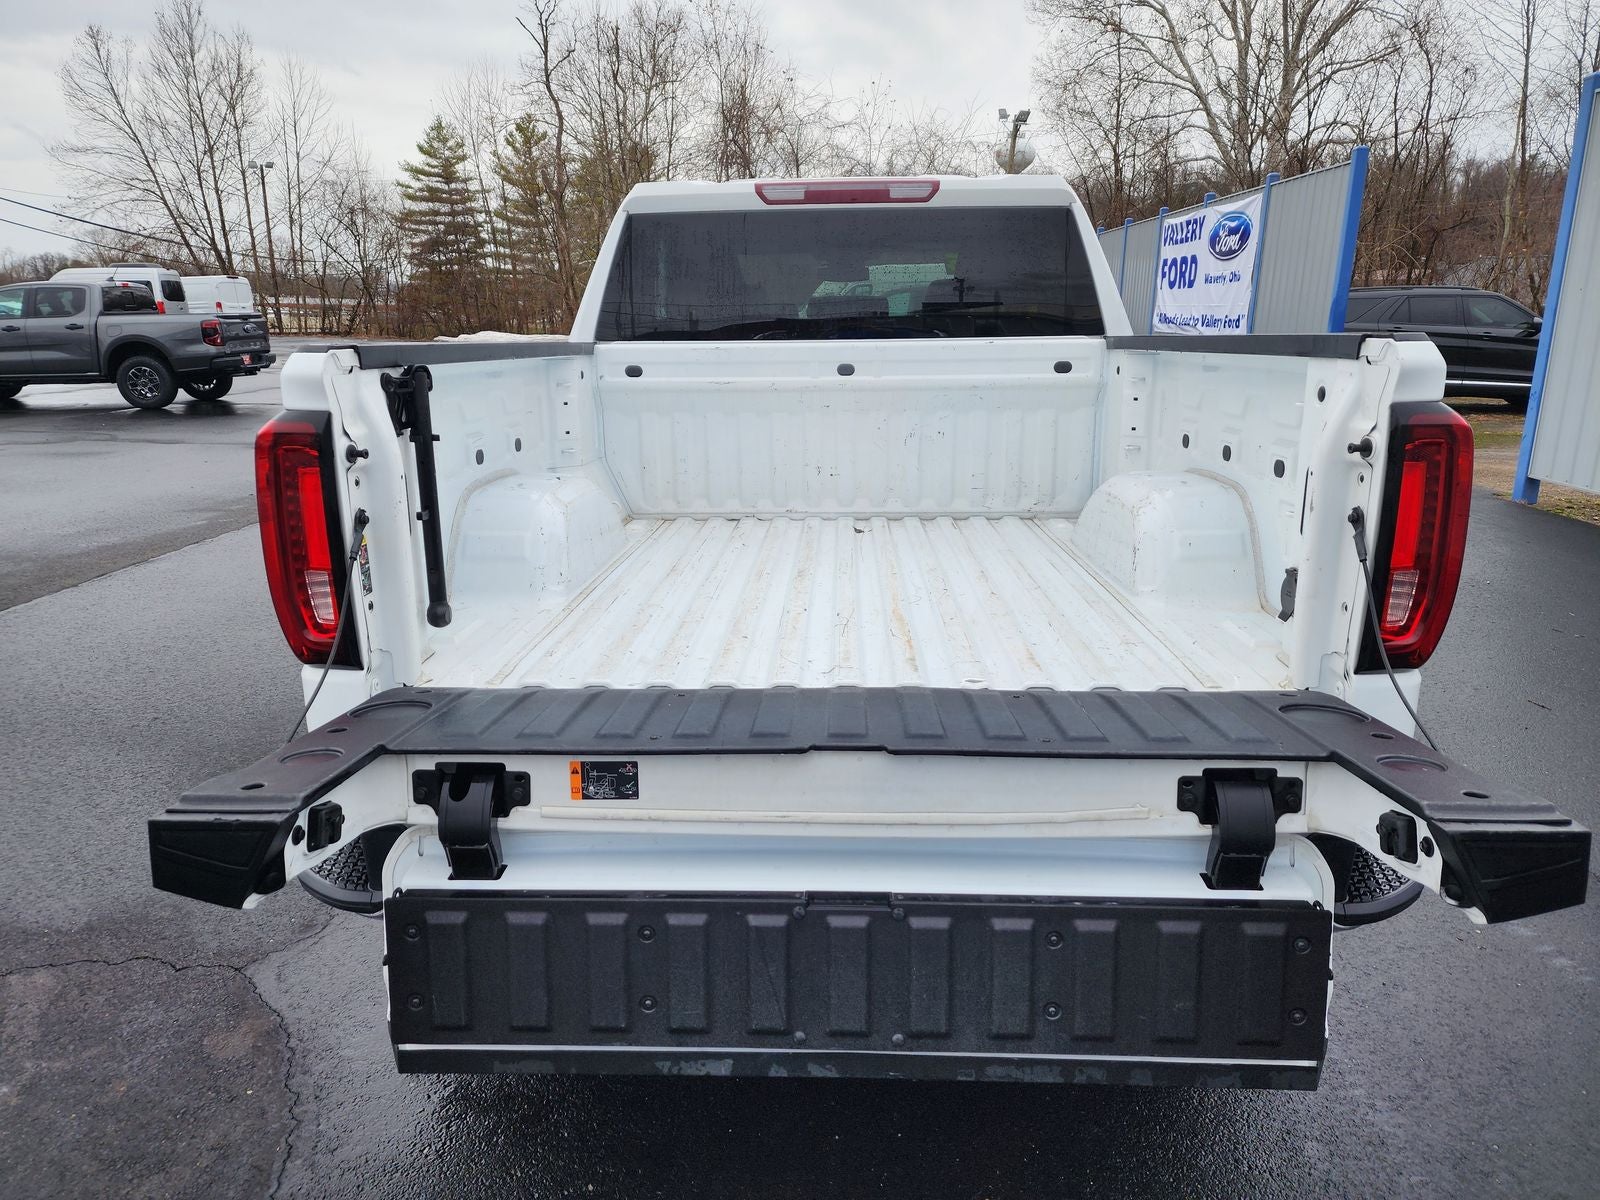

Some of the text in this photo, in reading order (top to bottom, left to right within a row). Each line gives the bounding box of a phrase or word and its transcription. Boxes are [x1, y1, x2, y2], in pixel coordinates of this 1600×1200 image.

[1163, 215, 1206, 247] VALLERY
[1215, 221, 1247, 253] Ford
[1160, 254, 1198, 290] FORD
[1228, 270, 1241, 283] Ohio
[1201, 314, 1222, 331] Vallery
